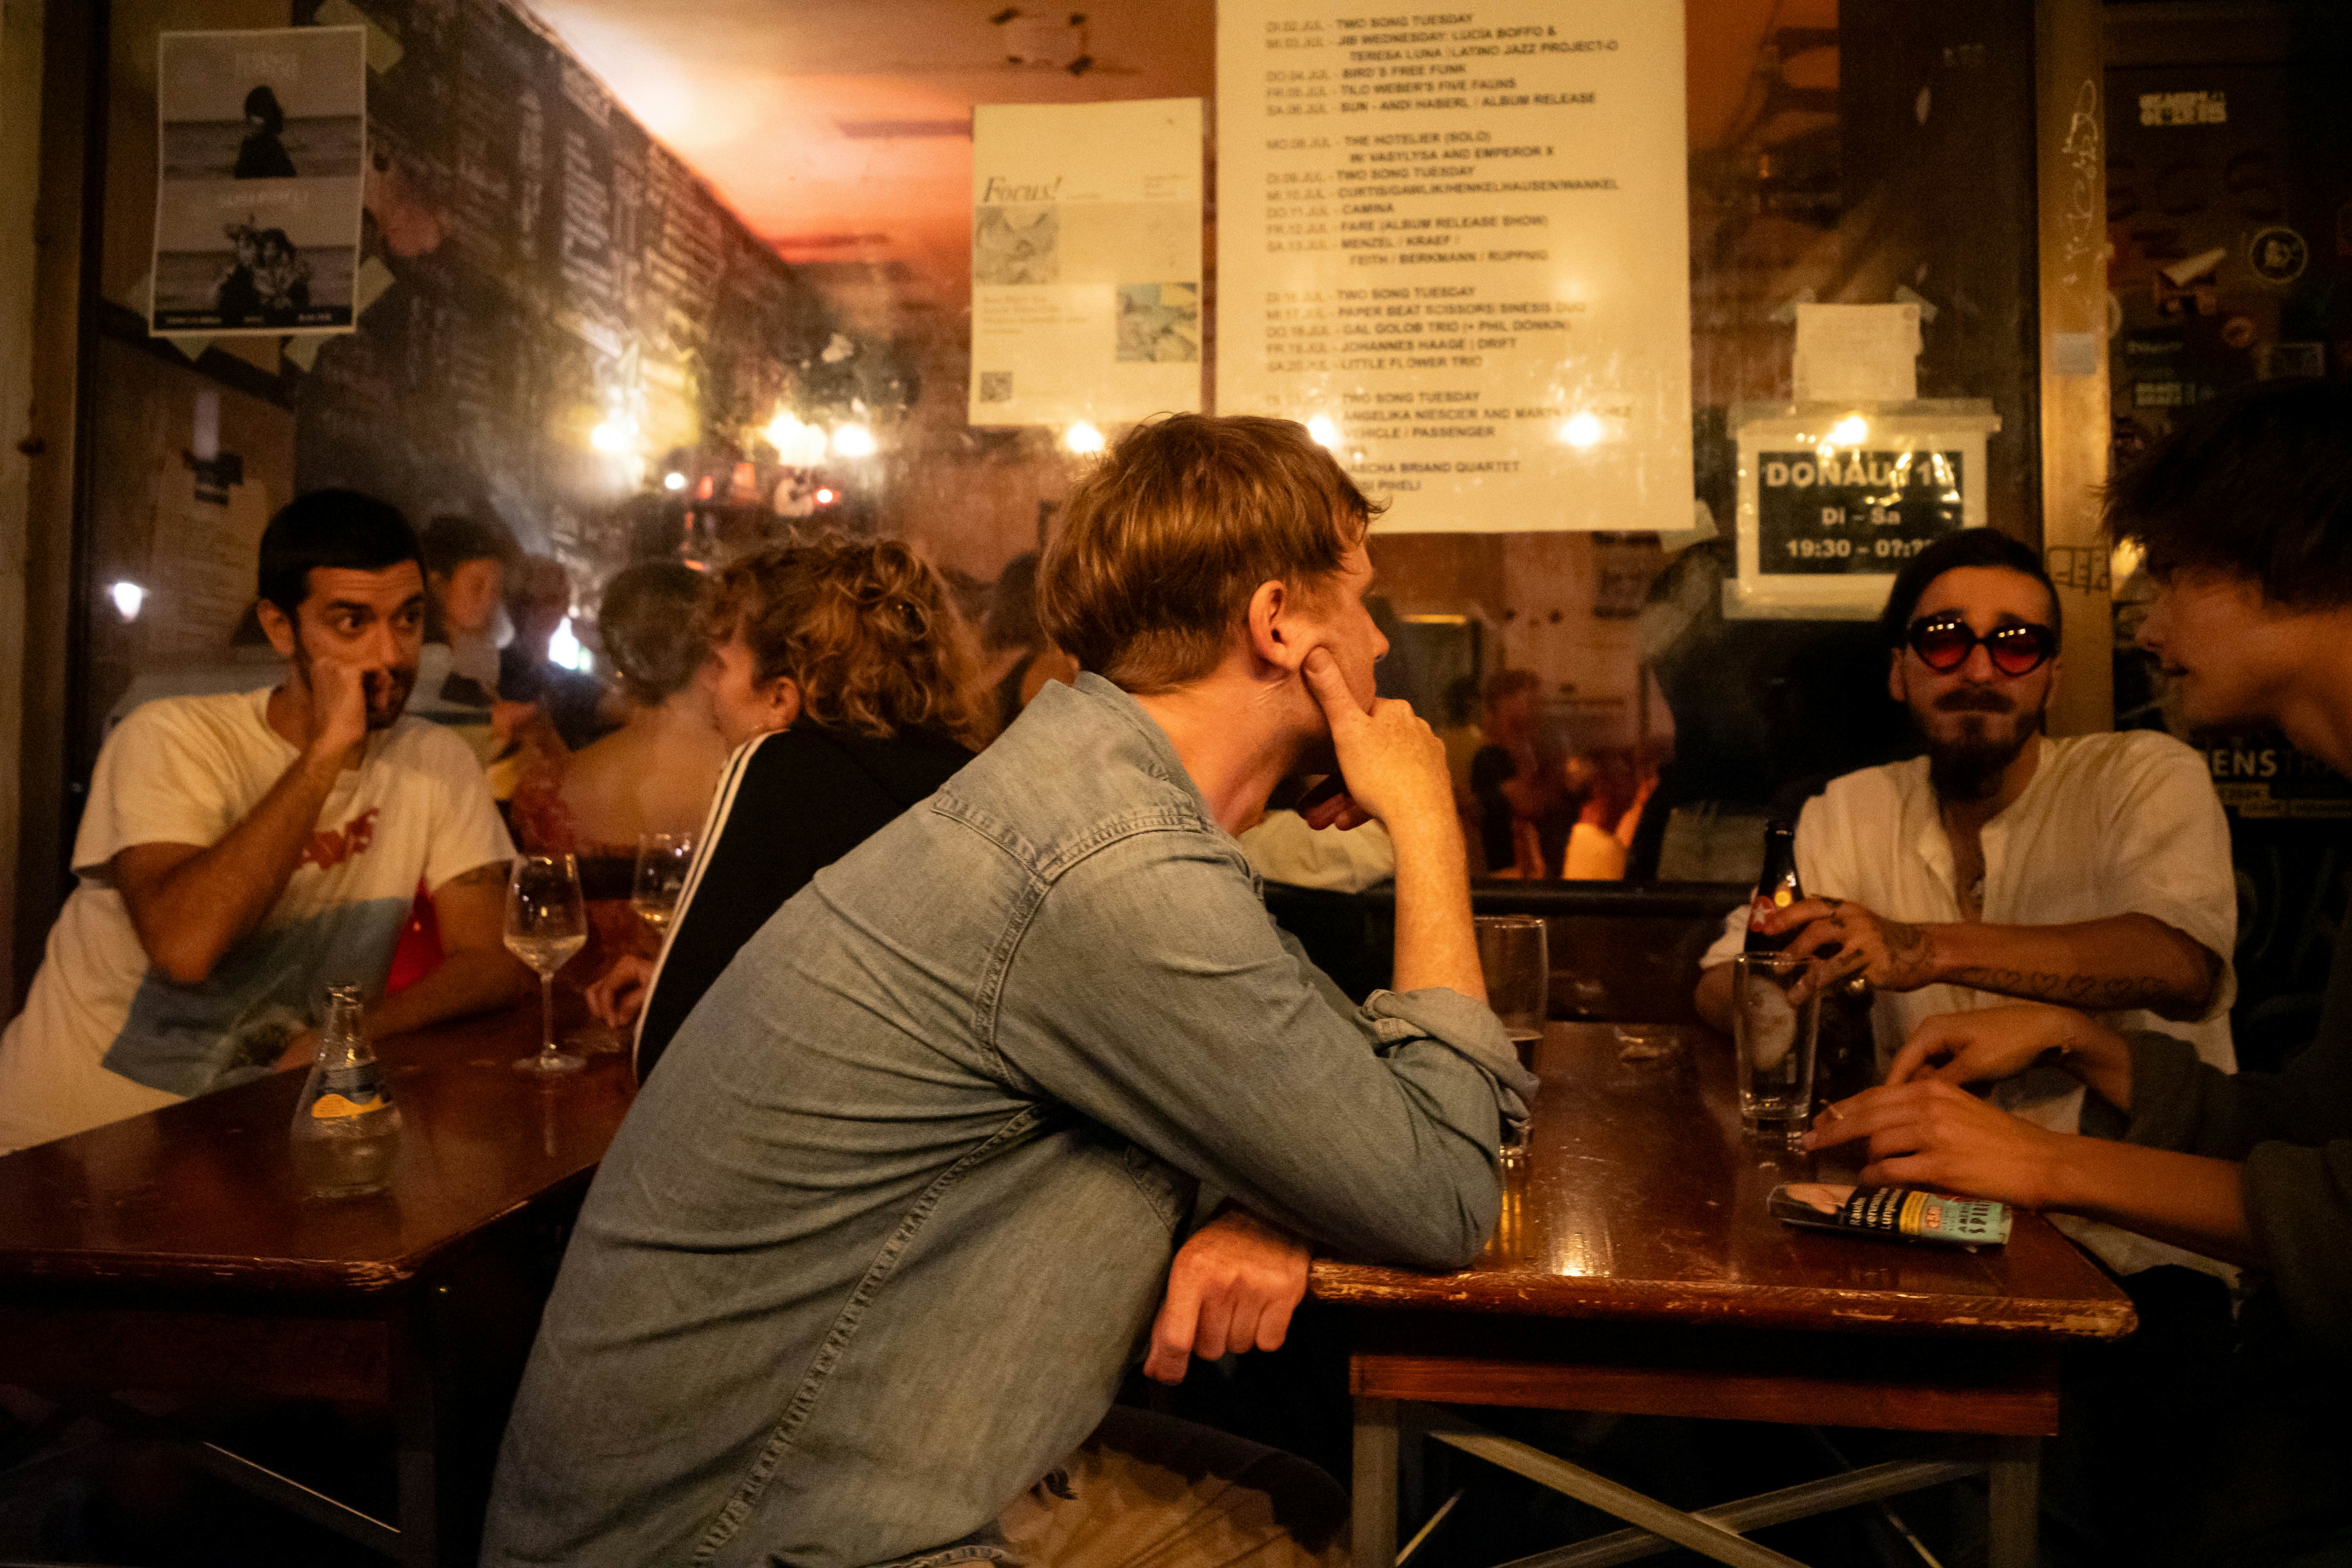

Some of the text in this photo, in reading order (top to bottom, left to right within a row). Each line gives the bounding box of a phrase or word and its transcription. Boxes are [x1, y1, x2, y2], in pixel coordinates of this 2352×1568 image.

[1336, 18, 1367, 29] TWO
[1369, 16, 1408, 27] SONG
[1412, 14, 1473, 26] TUESDAY
[1495, 27, 1544, 39] BOFFO
[1349, 49, 1402, 61] TERESA
[1405, 47, 1442, 59] LUNA
[1504, 44, 1537, 55] JAZZ
[1390, 65, 1426, 76] FREE
[1429, 64, 1466, 75] FUNK
[1340, 83, 1370, 95] TILO
[1437, 80, 1467, 91] FIVE
[1470, 78, 1517, 90] FAUNS
[1340, 101, 1368, 112] SUN
[1415, 97, 1469, 109] HABERL
[1481, 95, 1531, 107] ALBUM
[1532, 93, 1596, 105] RELEASE
[1344, 135, 1370, 146] THE
[1373, 132, 1441, 145] HOTELIER
[1444, 131, 1492, 143] (SOLO)
[1369, 149, 1438, 162] VASYLYSA
[1442, 149, 1471, 160] AND
[1473, 146, 1543, 158] EMPEROR
[1336, 169, 1367, 180] TWO
[1370, 167, 1410, 179] SONG
[1413, 165, 1475, 178] TUESDAY
[983, 176, 1063, 203] Focus!
[1341, 203, 1395, 214] CAMINA
[1339, 220, 1375, 232] FARE
[1379, 218, 1432, 230] (ALBUM
[1434, 216, 1499, 229] RELEASE
[1501, 215, 1549, 227] SHOW)
[1340, 237, 1393, 249] MENZEL
[1349, 254, 1389, 265] FEITH
[1398, 252, 1477, 264] BERKMANN
[1336, 289, 1367, 300] TWO
[1371, 288, 1410, 299] SONG
[1414, 286, 1476, 298] TUESDAY
[1338, 305, 1383, 317] PAPER
[1385, 305, 1421, 316] BEAT
[1555, 302, 1587, 312] DUO
[1343, 323, 1370, 334] GAL
[1374, 322, 1424, 334] GOLOB
[1427, 321, 1460, 333] TRIO
[1477, 321, 1507, 332] PHIL
[1341, 340, 1415, 352] JOHANNES
[1417, 339, 1466, 350] HAAGE
[1477, 338, 1517, 349] DRIFT
[1341, 358, 1386, 369] LITTLE
[1389, 357, 1448, 368] FLOWER
[1451, 356, 1483, 367] TRIO
[1341, 392, 1481, 403] TWO SONG TUESDAY
[1343, 409, 1411, 421] ANGELIKA
[1483, 408, 1511, 419] AND
[1411, 426, 1496, 438] PASSENGER
[1399, 462, 1452, 473] BRIAND
[1454, 461, 1520, 473] QUARTET
[1870, 507, 1901, 525] Sa
[1786, 539, 1851, 557] 19:30
